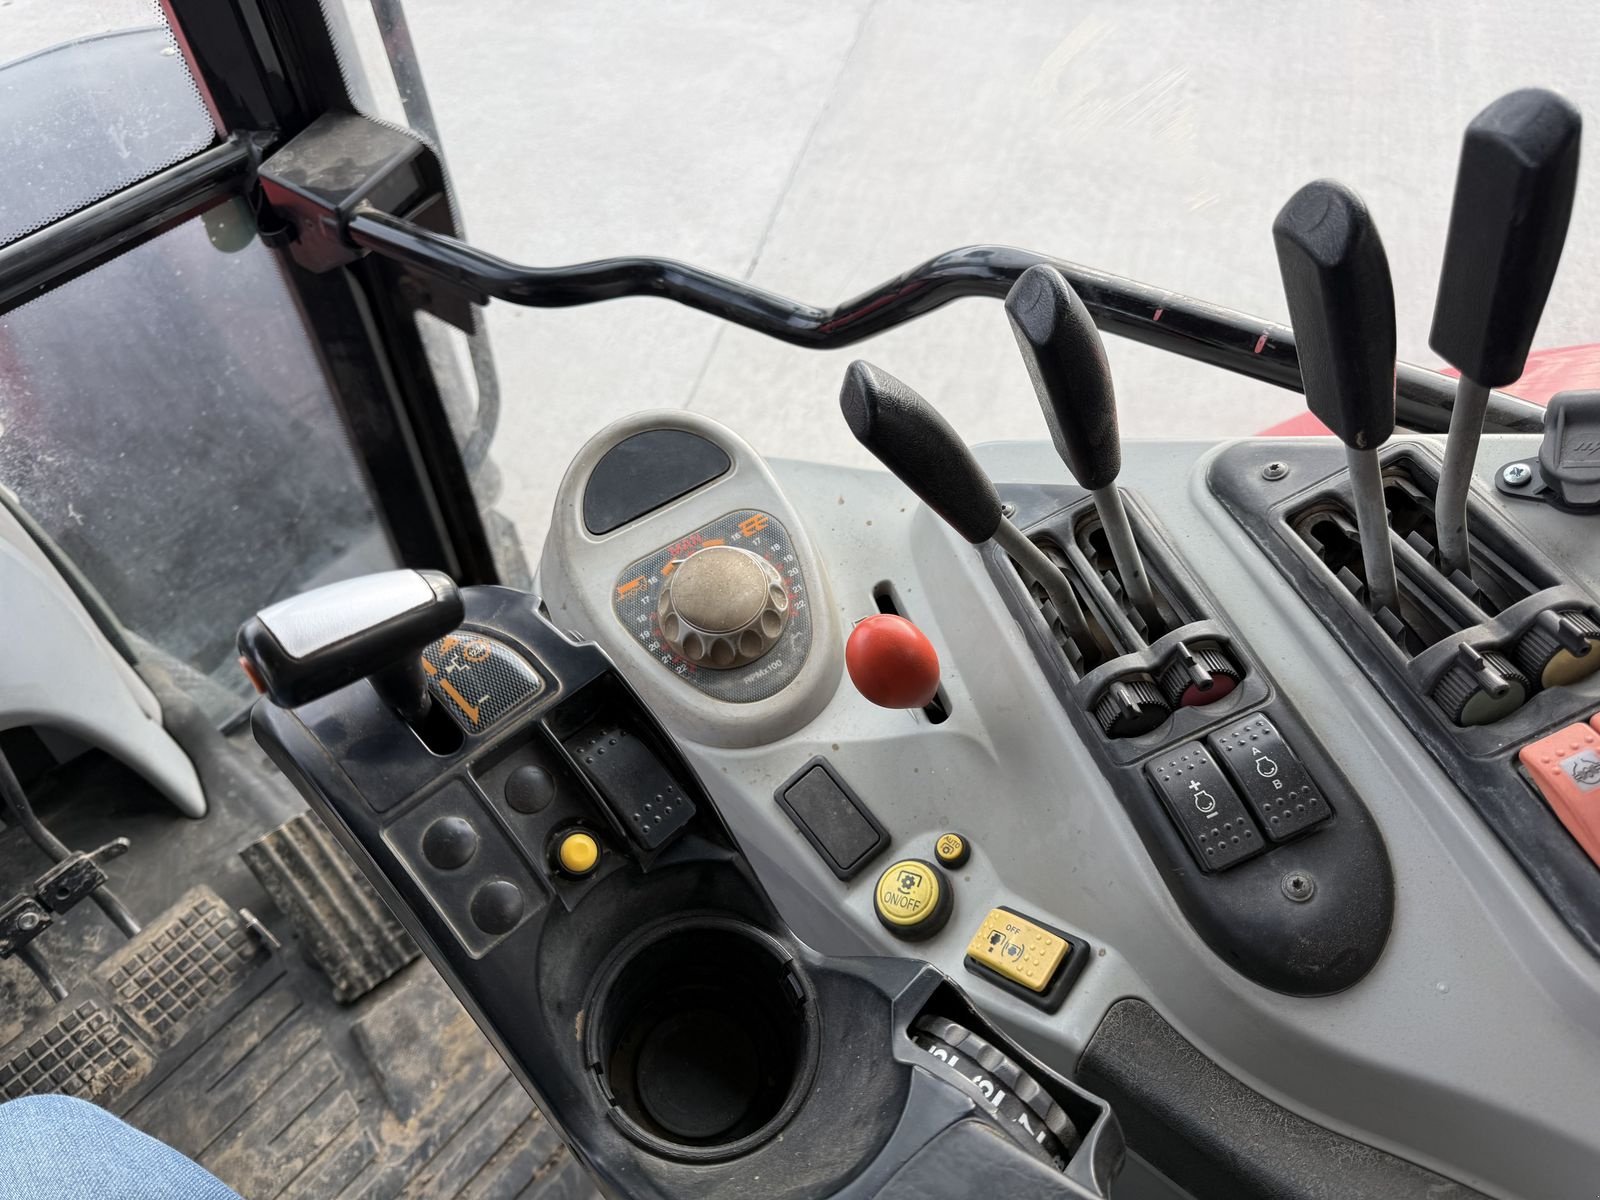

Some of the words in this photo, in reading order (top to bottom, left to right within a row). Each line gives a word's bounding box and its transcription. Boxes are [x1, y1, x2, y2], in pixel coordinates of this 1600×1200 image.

[731, 532, 742, 541] 16
[753, 537, 761, 546] 17
[771, 543, 781, 552] 18
[784, 554, 794, 563] 19
[787, 567, 799, 577] 20
[648, 576, 658, 585] 16
[792, 584, 802, 593] 21
[641, 595, 650, 605] 17
[794, 600, 807, 610] 22
[640, 630, 650, 640] 19
[648, 641, 660, 651] 20
[1251, 747, 1261, 756] A
[1272, 779, 1283, 790] B
[943, 836, 960, 849] AUTO
[883, 891, 922, 912] ON/OFF
[1005, 924, 1021, 935] OFF
